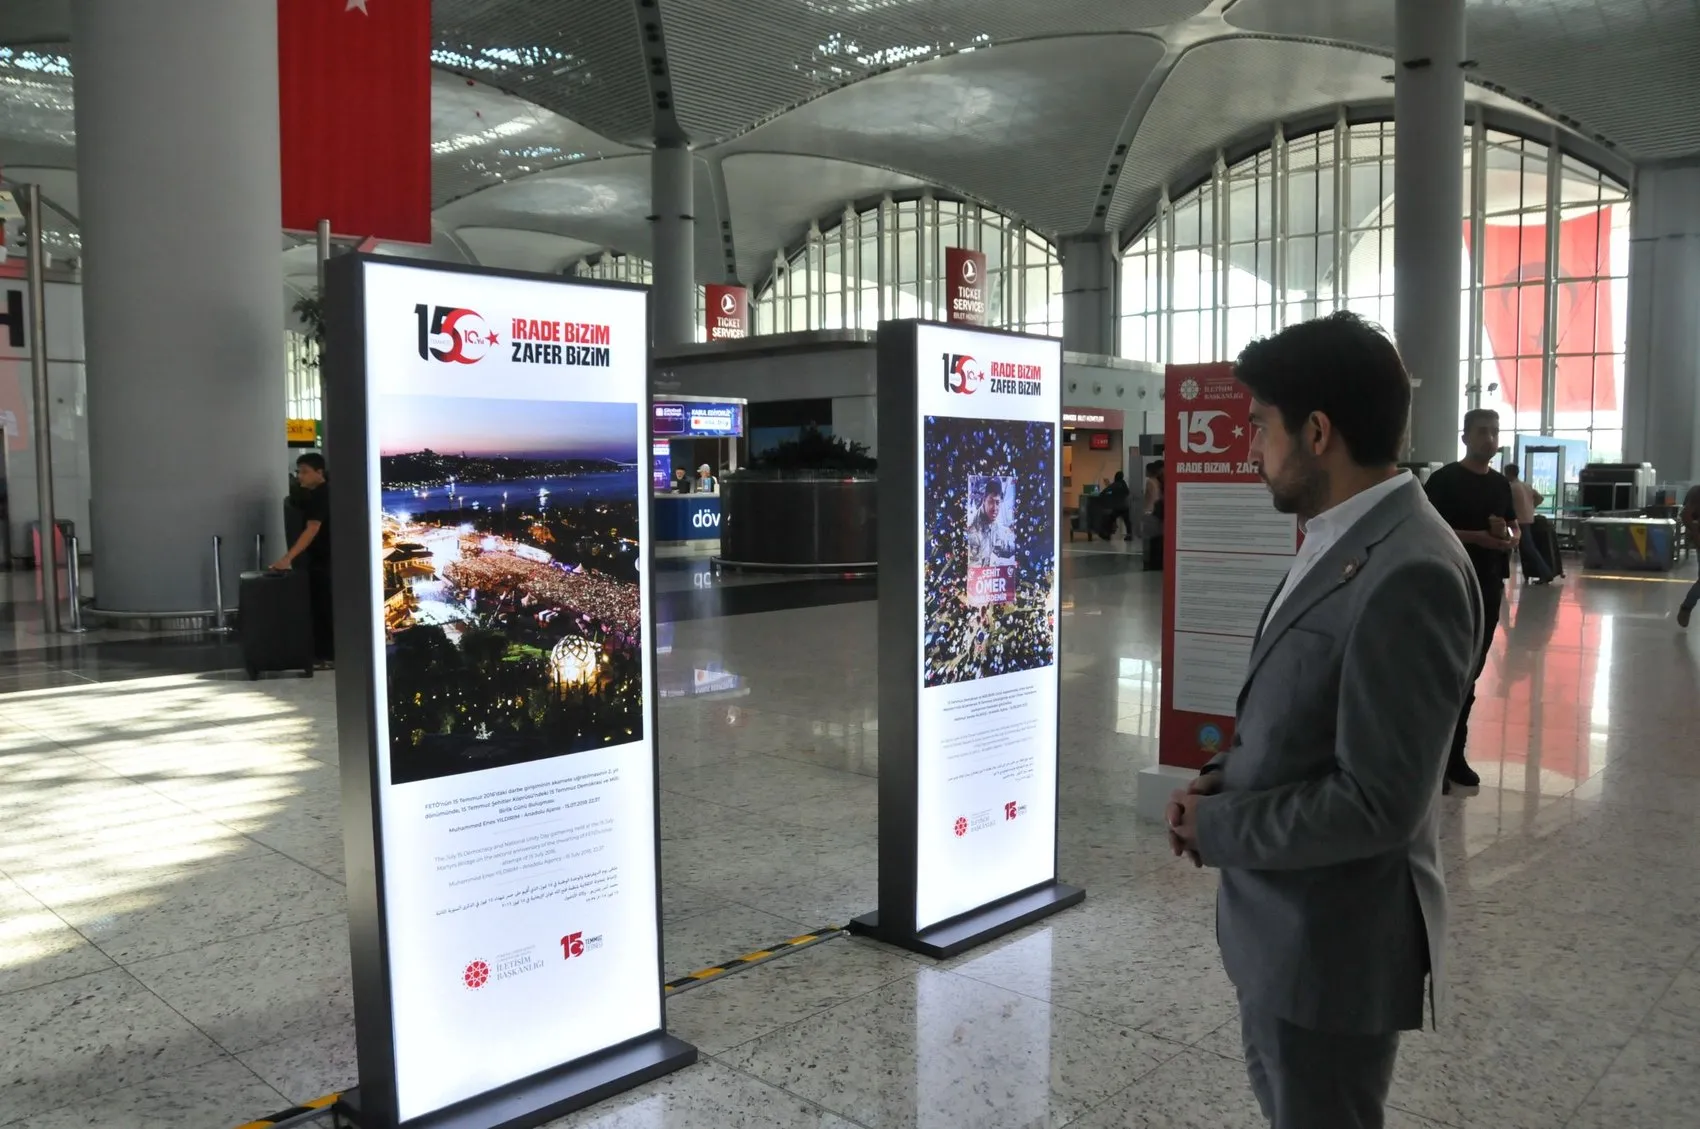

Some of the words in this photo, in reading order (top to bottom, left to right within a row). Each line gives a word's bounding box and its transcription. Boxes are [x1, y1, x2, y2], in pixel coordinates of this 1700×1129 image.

[958, 286, 981, 300] TICKET
[953, 298, 985, 312] SERVICES
[716, 316, 740, 328] TICKET
[712, 327, 744, 339] SERVICES
[511, 342, 562, 366] ZAFER
[566, 345, 610, 367] BİZİM
[990, 379, 1016, 394] ZAFER
[1018, 380, 1042, 396] BİZİM
[976, 578, 1006, 594] ÖMER
[459, 795, 483, 803] Temmuz
[468, 803, 490, 811] Temmuz
[577, 780, 602, 789] Demokrasi
[528, 799, 555, 809] Buluşması
[449, 821, 482, 832] Muhammed
[524, 808, 545, 817] Anadolu
[464, 846, 493, 856] Democracy
[505, 837, 526, 847] National
